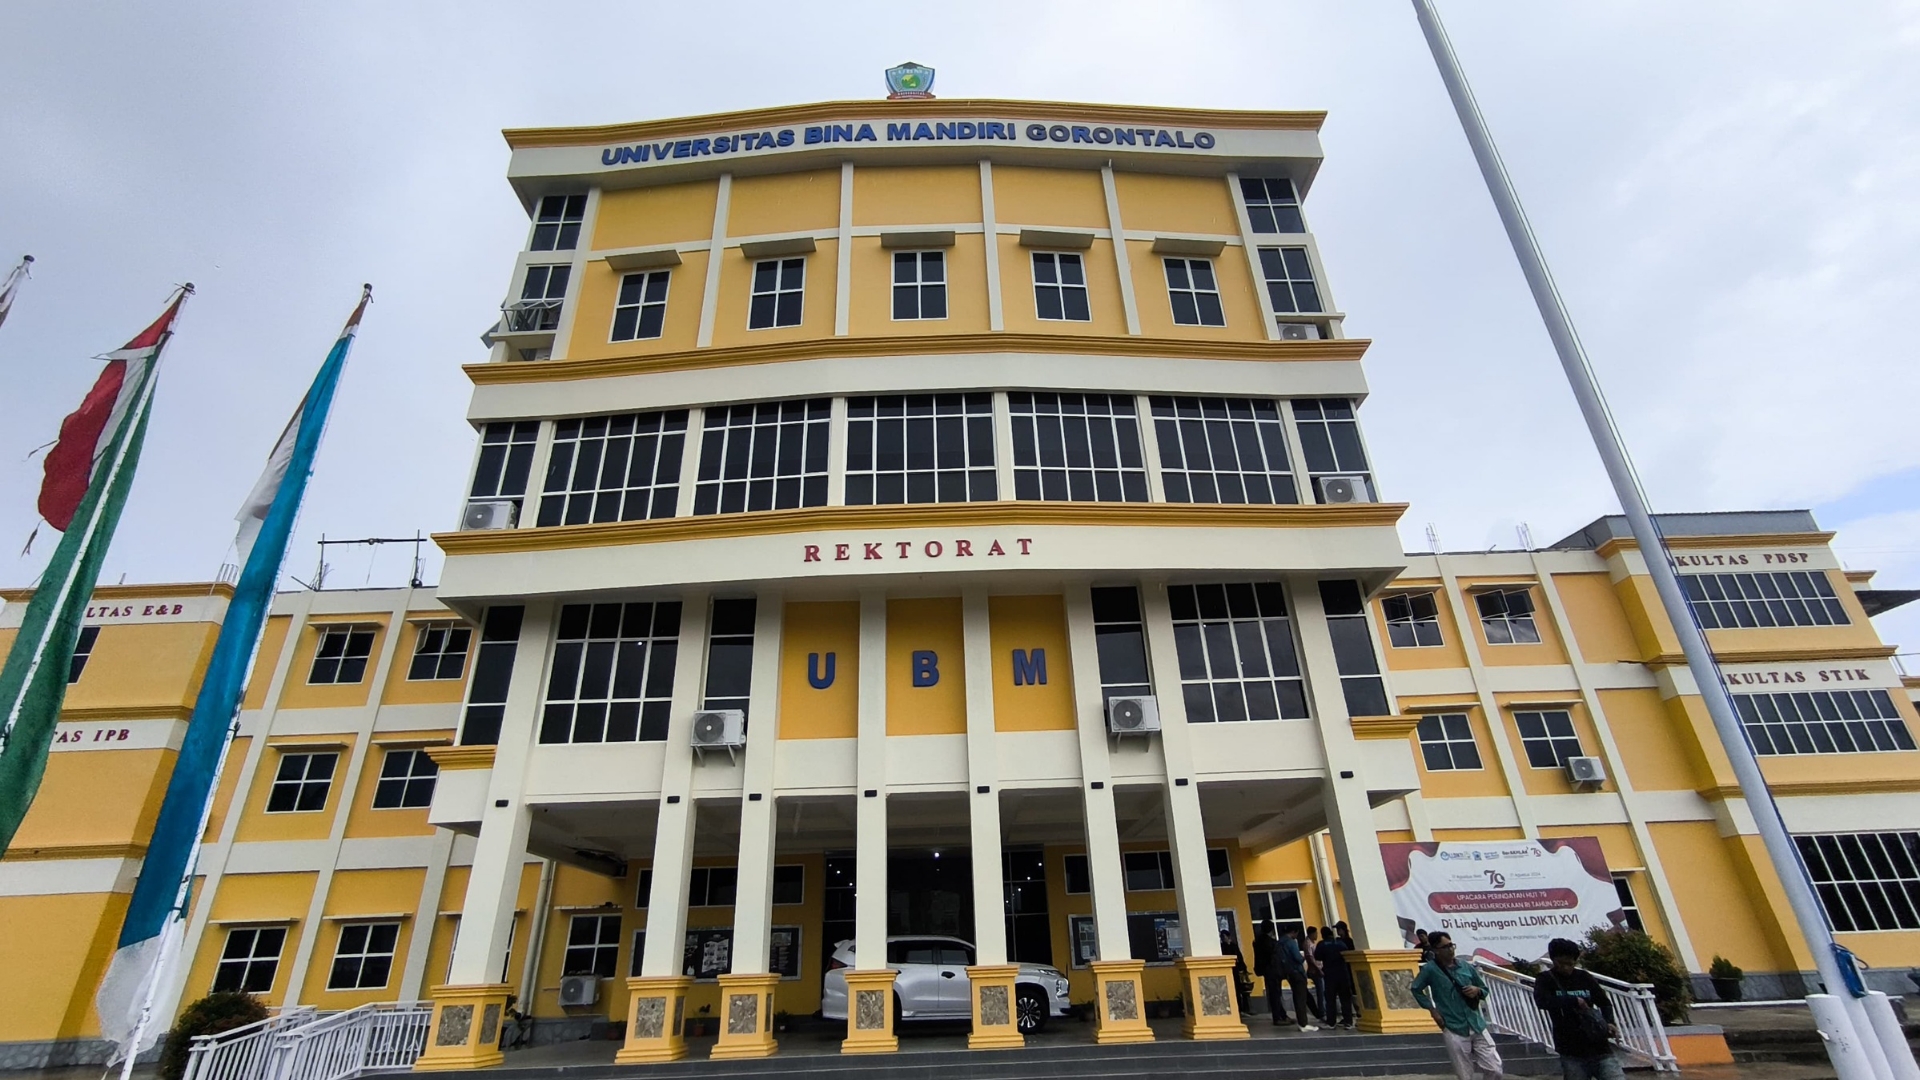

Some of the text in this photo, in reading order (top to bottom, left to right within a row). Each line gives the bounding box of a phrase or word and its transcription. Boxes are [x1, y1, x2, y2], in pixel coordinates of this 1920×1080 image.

[601, 121, 1216, 166] UNIVERSITAS BINA MANDIRI GORONTALO
[803, 538, 1033, 563] REKTORAT
[1675, 552, 1809, 567] KULTAS PDSP
[86, 604, 184, 618] LTAS E&B
[808, 648, 1048, 689] U B M
[1726, 669, 1871, 685] KULTAS STIK
[93, 729, 130, 742] IPB
[1483, 869, 1506, 889] 79
[1441, 913, 1580, 931] Di Lingkungan LLDIKTI XVI
